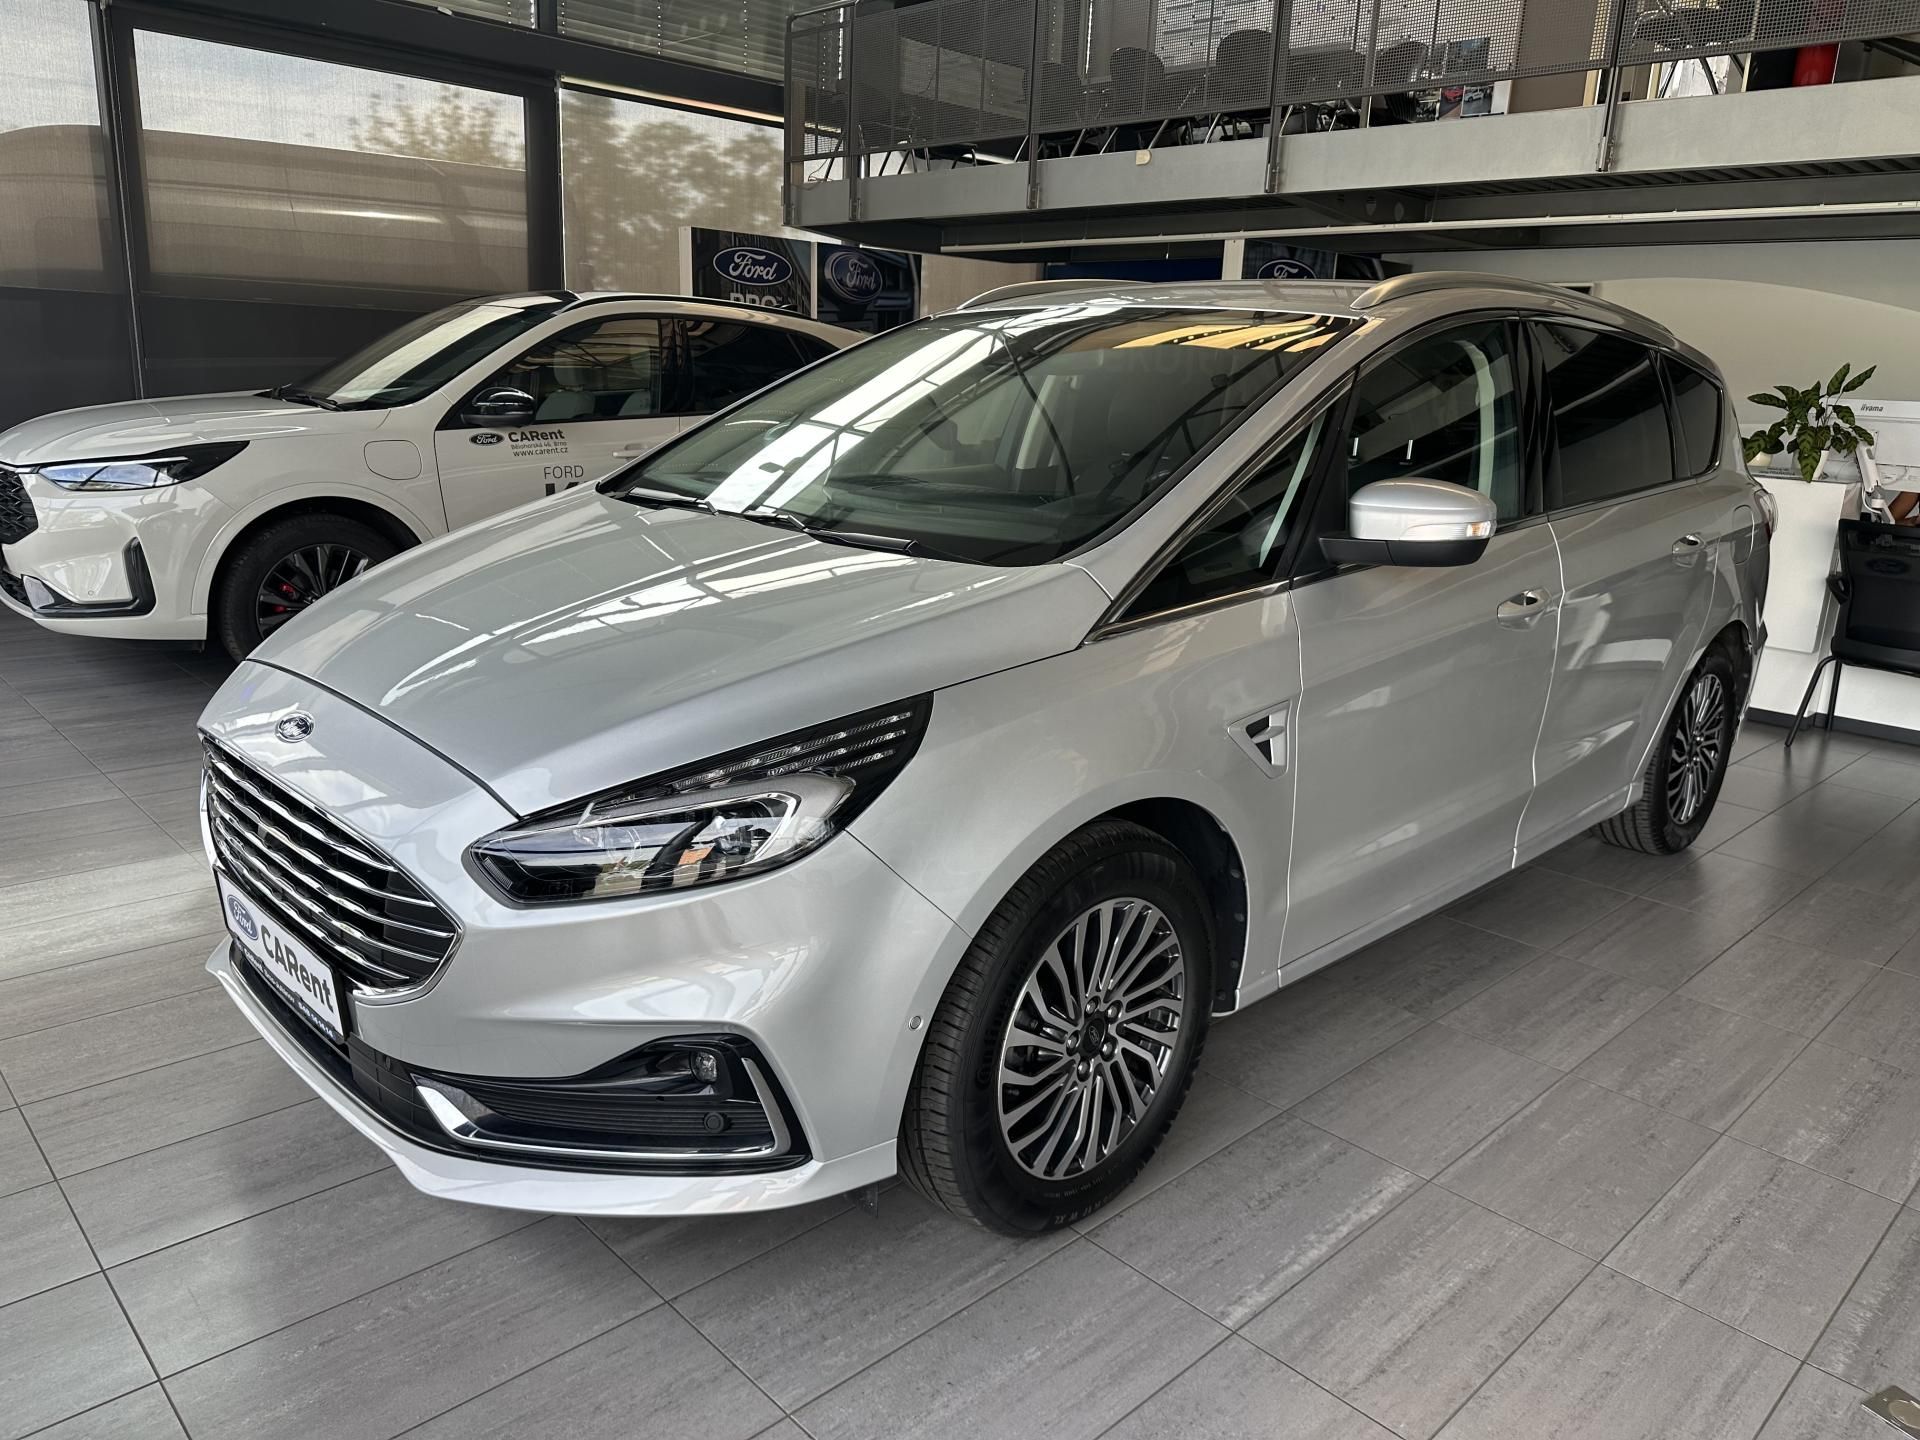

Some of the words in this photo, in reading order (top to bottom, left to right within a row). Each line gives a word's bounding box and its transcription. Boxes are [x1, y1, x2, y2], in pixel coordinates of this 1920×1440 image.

[728, 251, 778, 281] Ford
[846, 258, 876, 290] Ford
[1860, 403, 1884, 412] iiyama
[476, 434, 497, 444] Ford
[508, 429, 565, 443] CARent
[513, 446, 568, 457] www.carent.cz
[543, 465, 585, 480] FORD
[233, 901, 253, 934] Ford
[261, 924, 334, 1013] CARent
